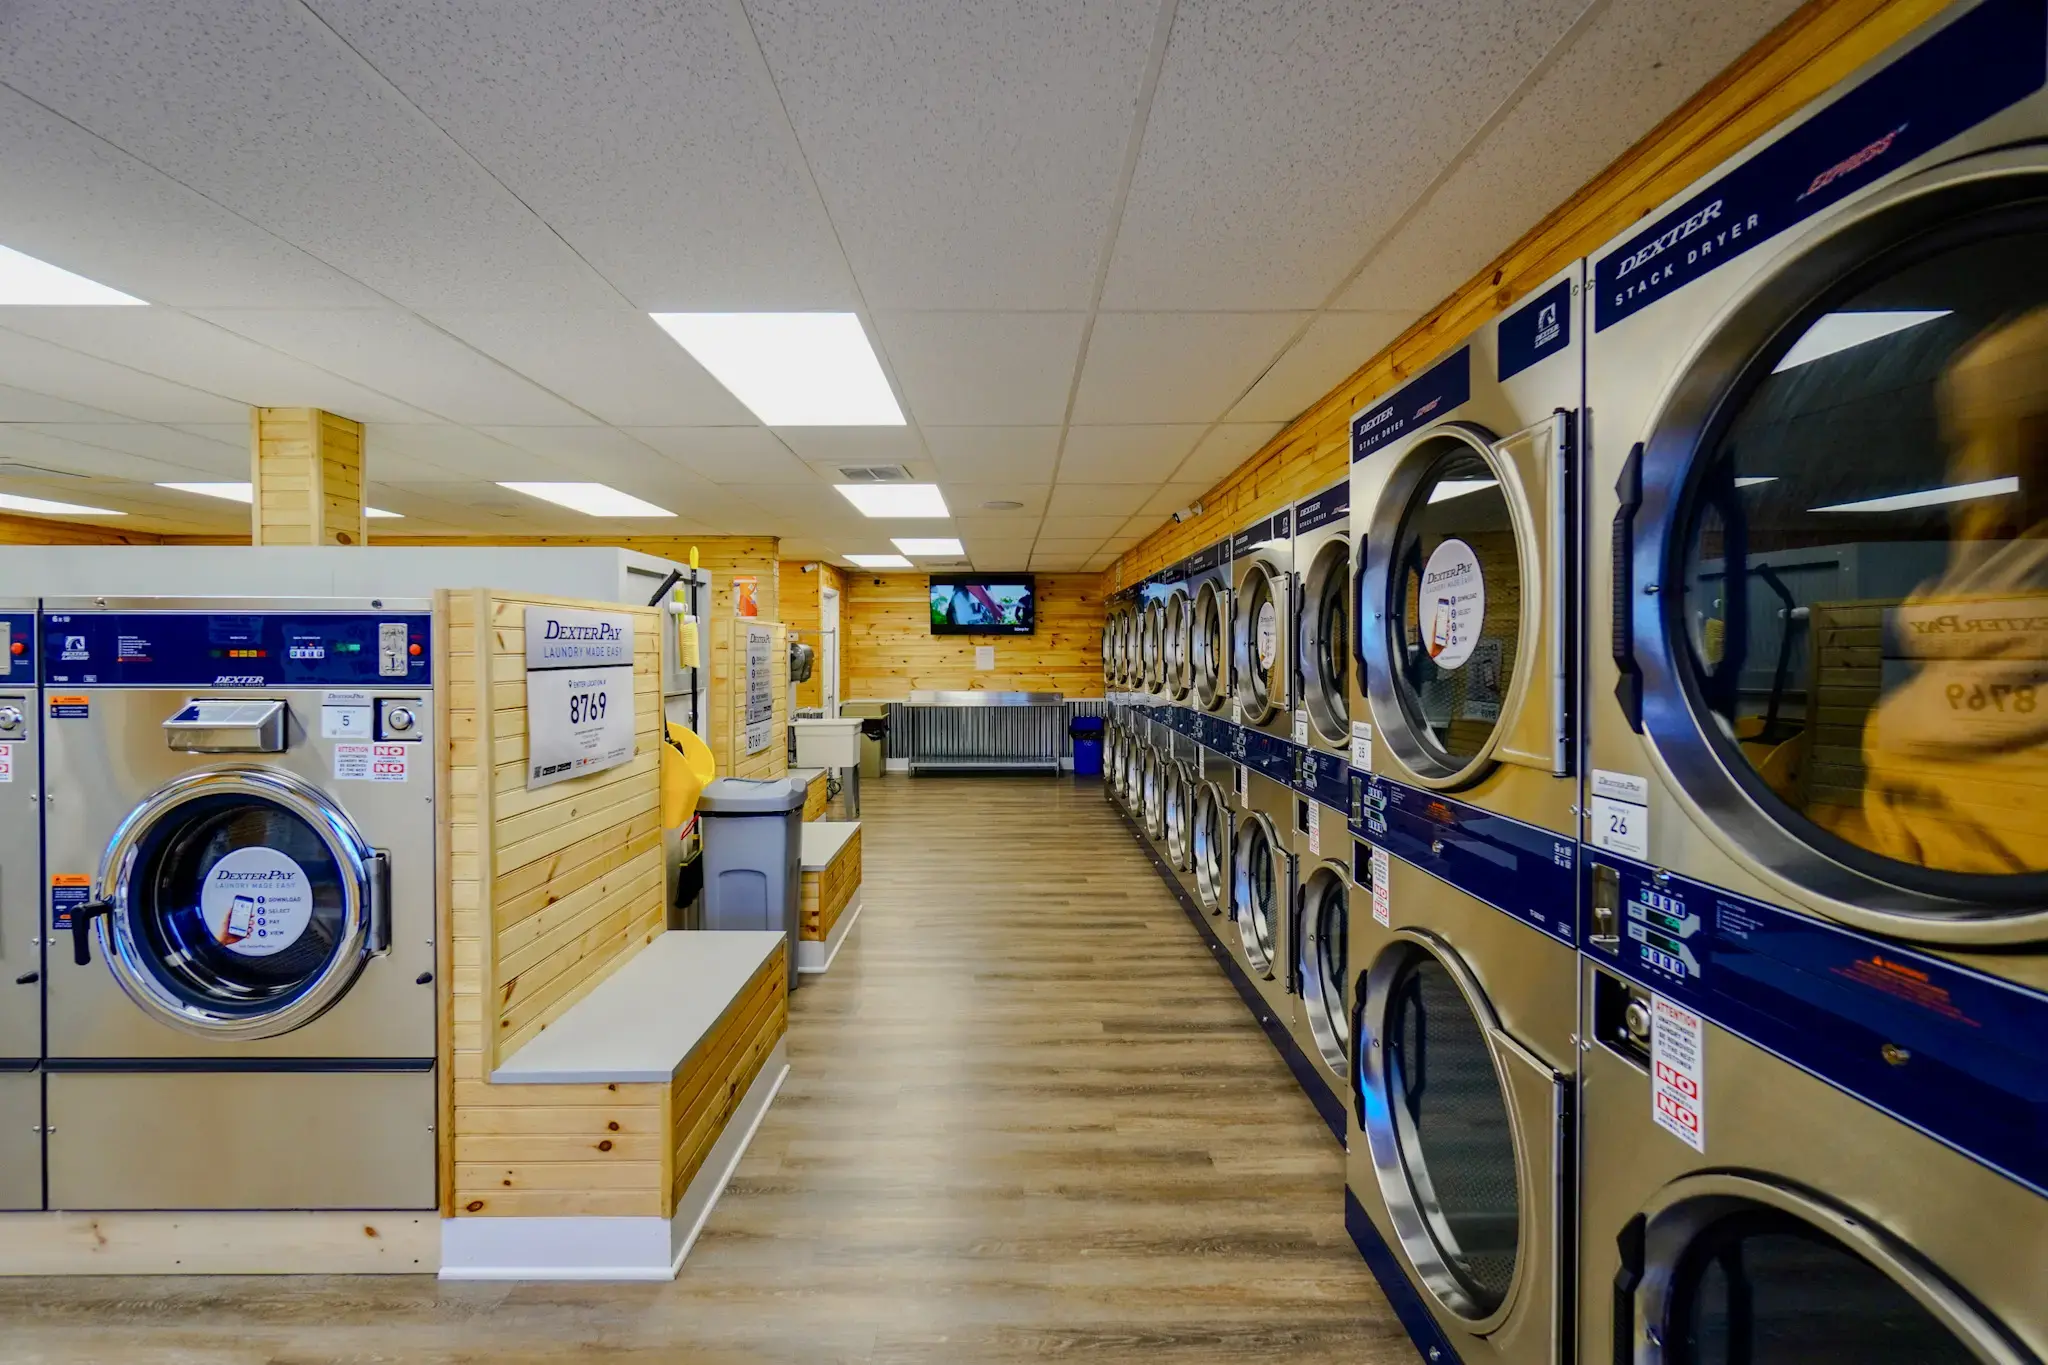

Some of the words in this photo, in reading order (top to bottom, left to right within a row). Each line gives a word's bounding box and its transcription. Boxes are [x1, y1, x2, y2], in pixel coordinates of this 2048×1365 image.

[1615, 200, 1723, 280] DEXTER
[1615, 264, 1674, 306] STACK
[1687, 214, 1759, 264] DRYER
[1359, 406, 1394, 435] DEXTER
[1359, 434, 1379, 451] STACK
[1382, 419, 1404, 438] DRYER
[1300, 502, 1321, 517] DEXTER
[544, 645, 583, 658] LAUNDRY
[586, 647, 605, 657] MADE
[607, 646, 623, 657] EASY
[214, 676, 264, 684] DEXTER
[570, 692, 606, 724] 8769
[342, 715, 350, 727] 5
[375, 746, 404, 756] NO
[375, 764, 404, 773] NO
[1610, 814, 1628, 835] 26
[1374, 884, 1387, 900] NO
[1374, 901, 1387, 917] NO
[1656, 1001, 1696, 1028] ATTENTION
[1656, 1022, 1681, 1038] LAUNDRY
[1668, 1036, 1694, 1055] REMOVED
[1668, 1044, 1678, 1054] THE
[1680, 1052, 1696, 1064] NEXT
[1661, 1049, 1692, 1071] CUSTOMER
[1658, 1062, 1696, 1099] NO
[1658, 1093, 1697, 1131] NO
